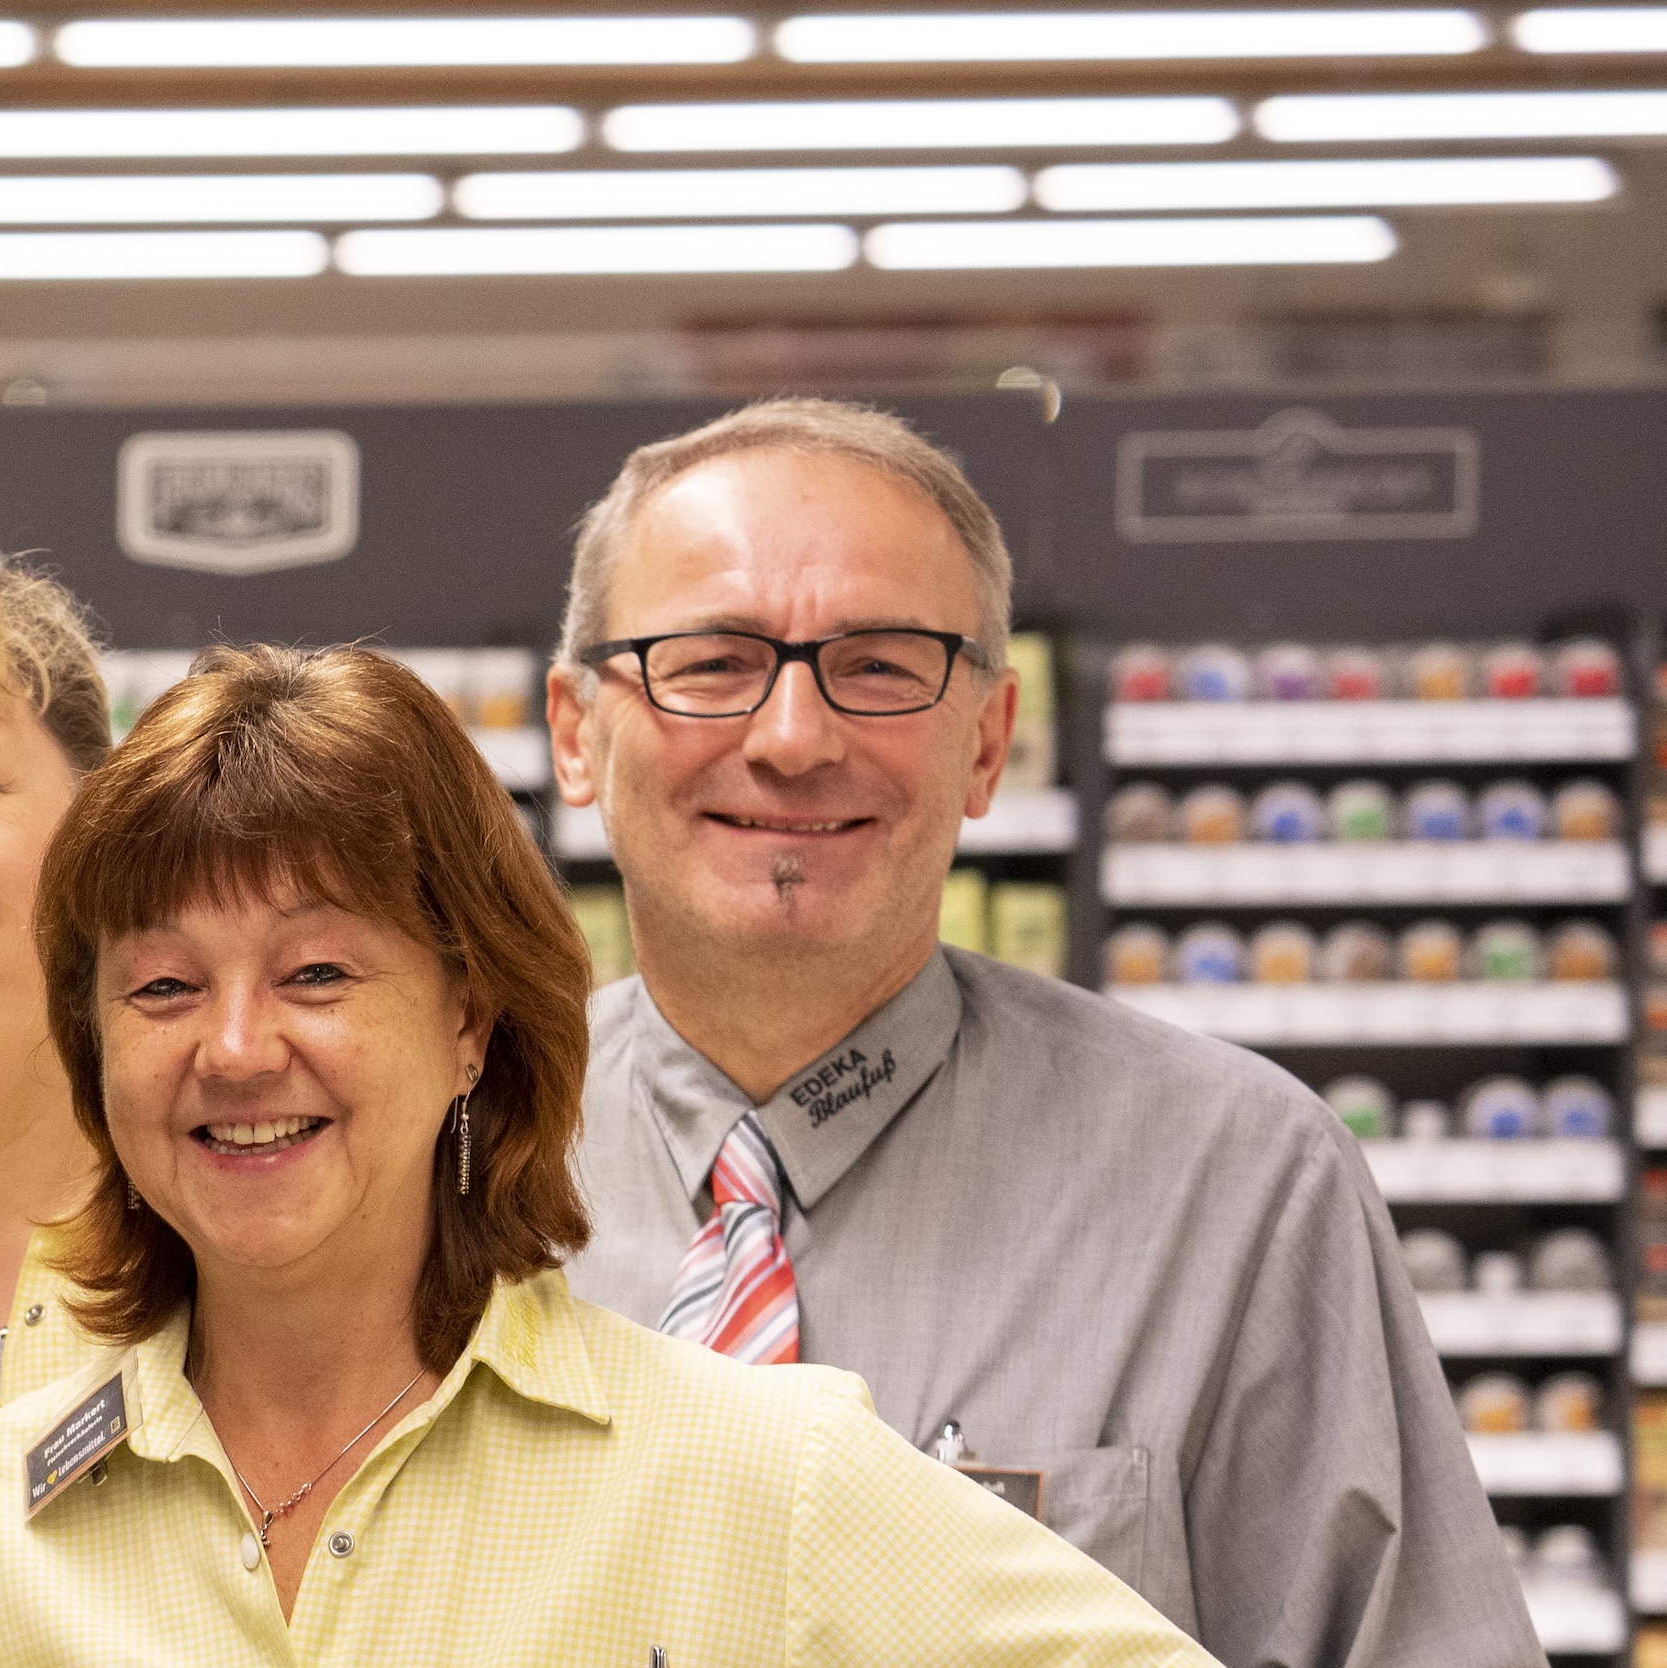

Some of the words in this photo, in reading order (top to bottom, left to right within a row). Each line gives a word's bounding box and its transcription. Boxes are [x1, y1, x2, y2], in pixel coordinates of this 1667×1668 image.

[788, 1048, 866, 1108] EDEKA
[44, 1435, 65, 1459] Frau
[66, 1399, 106, 1437] Markert
[32, 1482, 47, 1498] Wir
